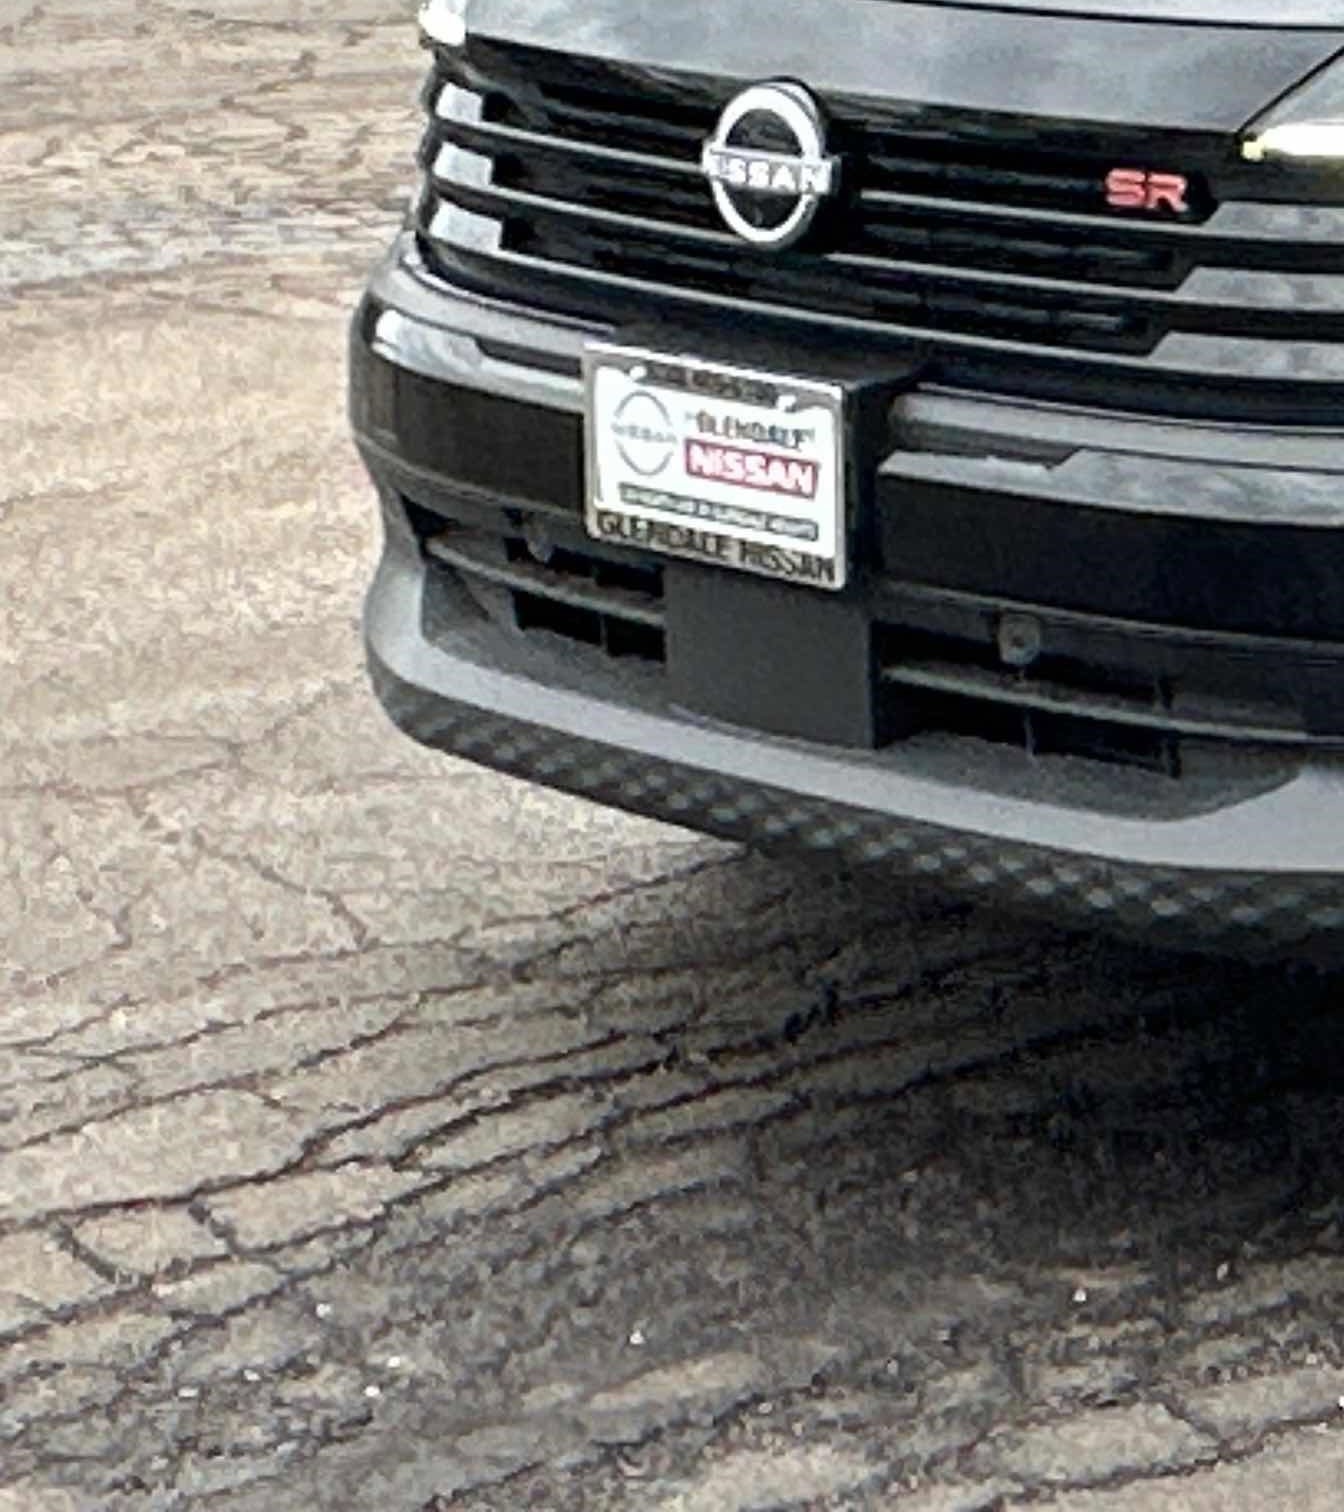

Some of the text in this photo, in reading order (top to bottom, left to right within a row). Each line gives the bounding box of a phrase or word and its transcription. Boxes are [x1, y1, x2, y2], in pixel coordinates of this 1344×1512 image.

[706, 152, 833, 194] NISSAN
[1104, 168, 1190, 213] SR
[688, 440, 814, 495] NISSAN
[739, 540, 836, 583] NISSAN
